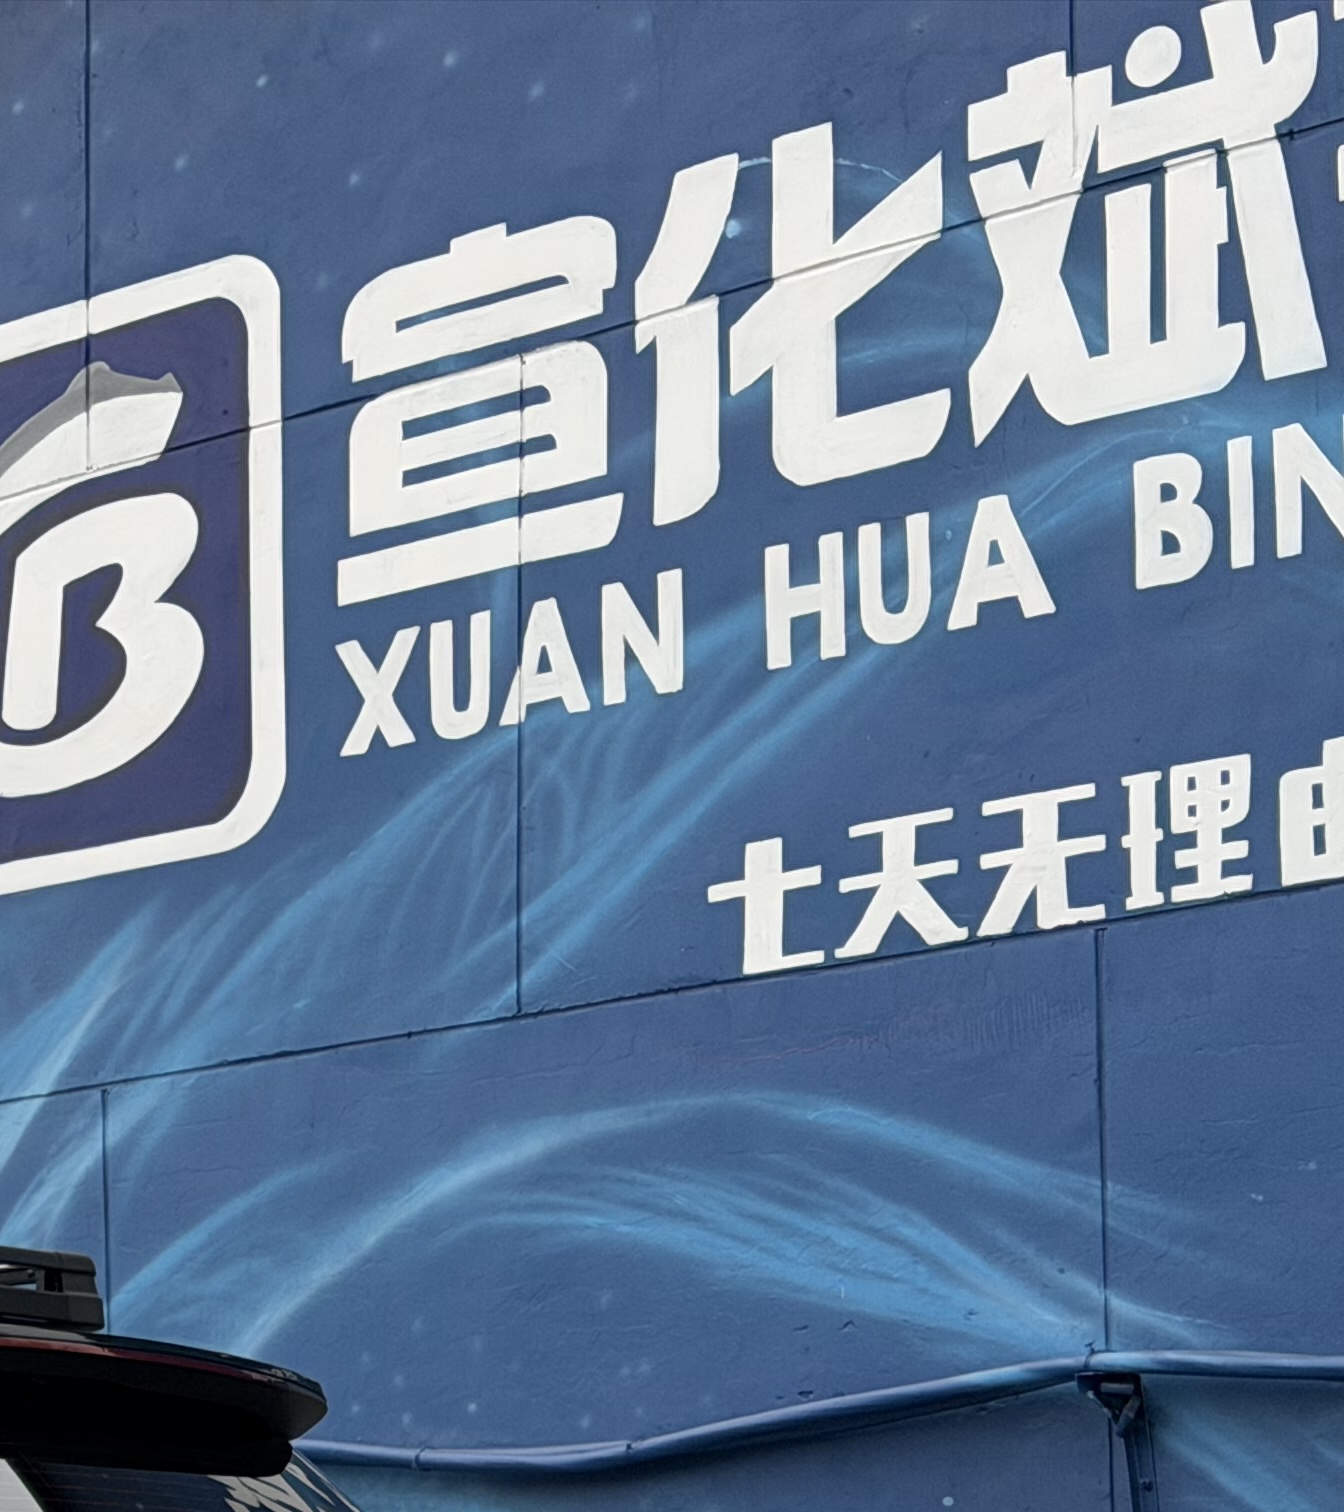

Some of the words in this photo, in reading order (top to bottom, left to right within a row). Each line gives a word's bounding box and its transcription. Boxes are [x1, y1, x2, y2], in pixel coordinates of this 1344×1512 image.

[337, 0, 1344, 606] 宣化斌
[336, 568, 683, 757] XUAN
[764, 495, 1056, 670] HUA
